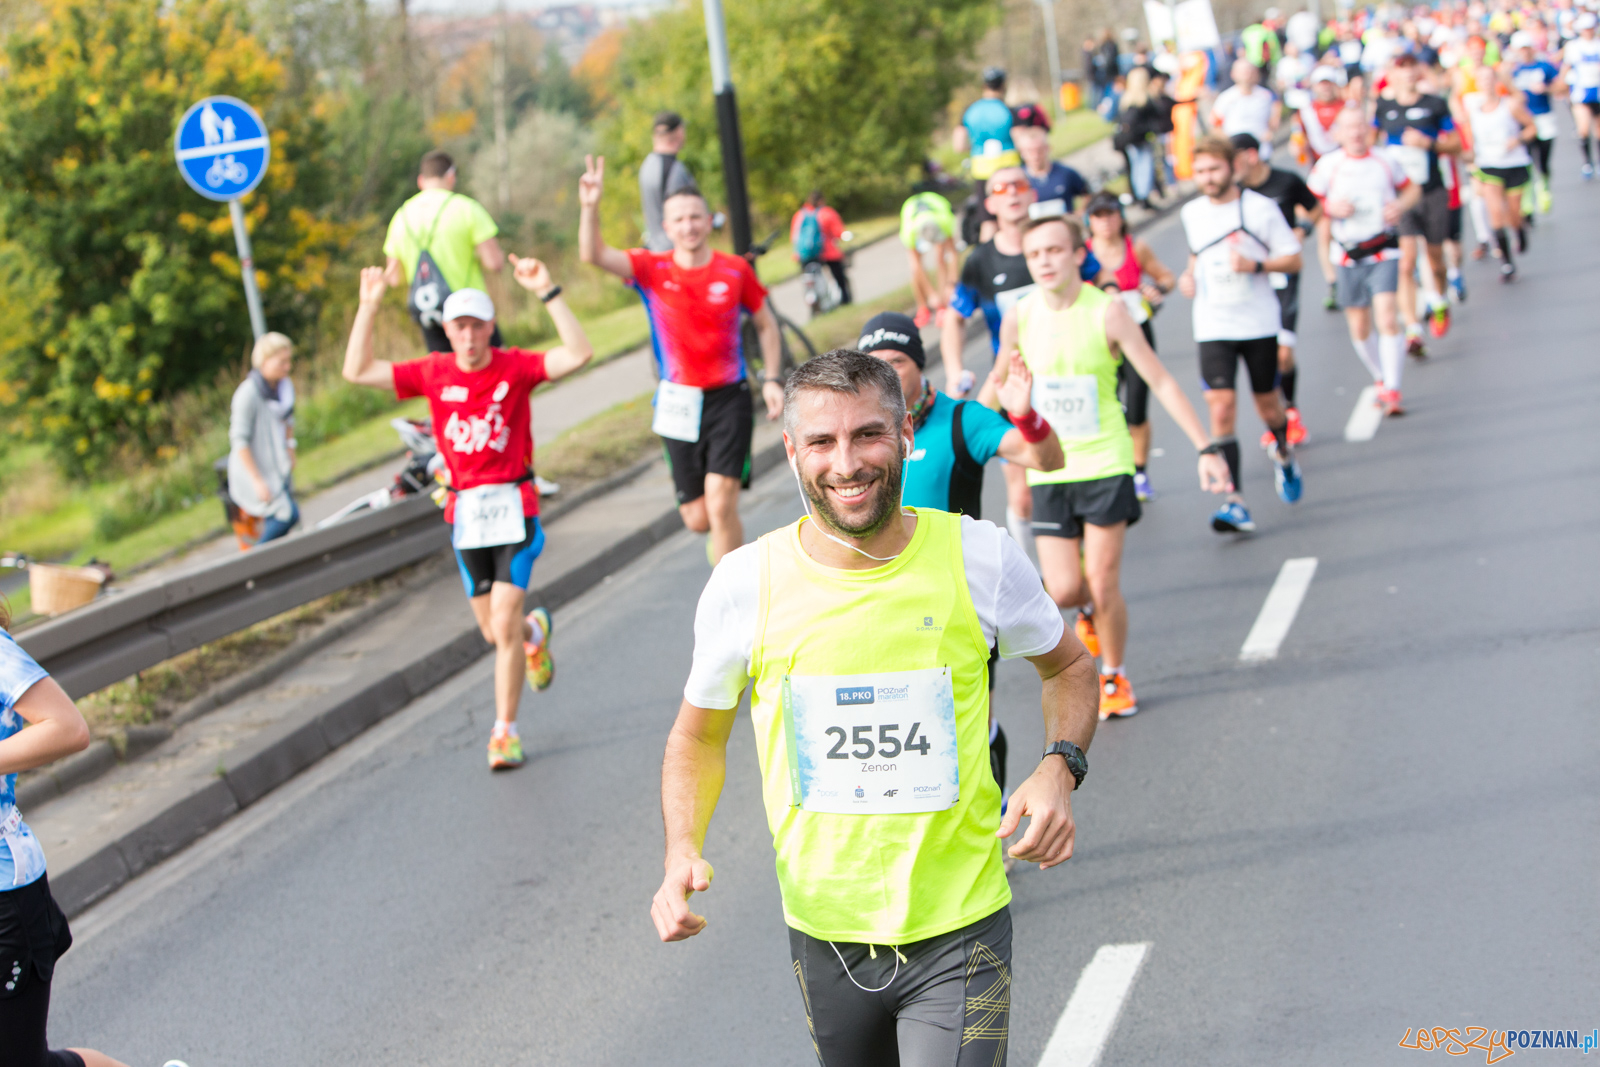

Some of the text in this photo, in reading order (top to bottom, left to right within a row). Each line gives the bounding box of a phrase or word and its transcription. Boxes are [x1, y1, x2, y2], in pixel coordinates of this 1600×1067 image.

[839, 690, 872, 701] 18. PKO
[877, 692, 909, 701] maraton
[824, 721, 931, 760] 2554
[861, 763, 897, 772] Zenon
